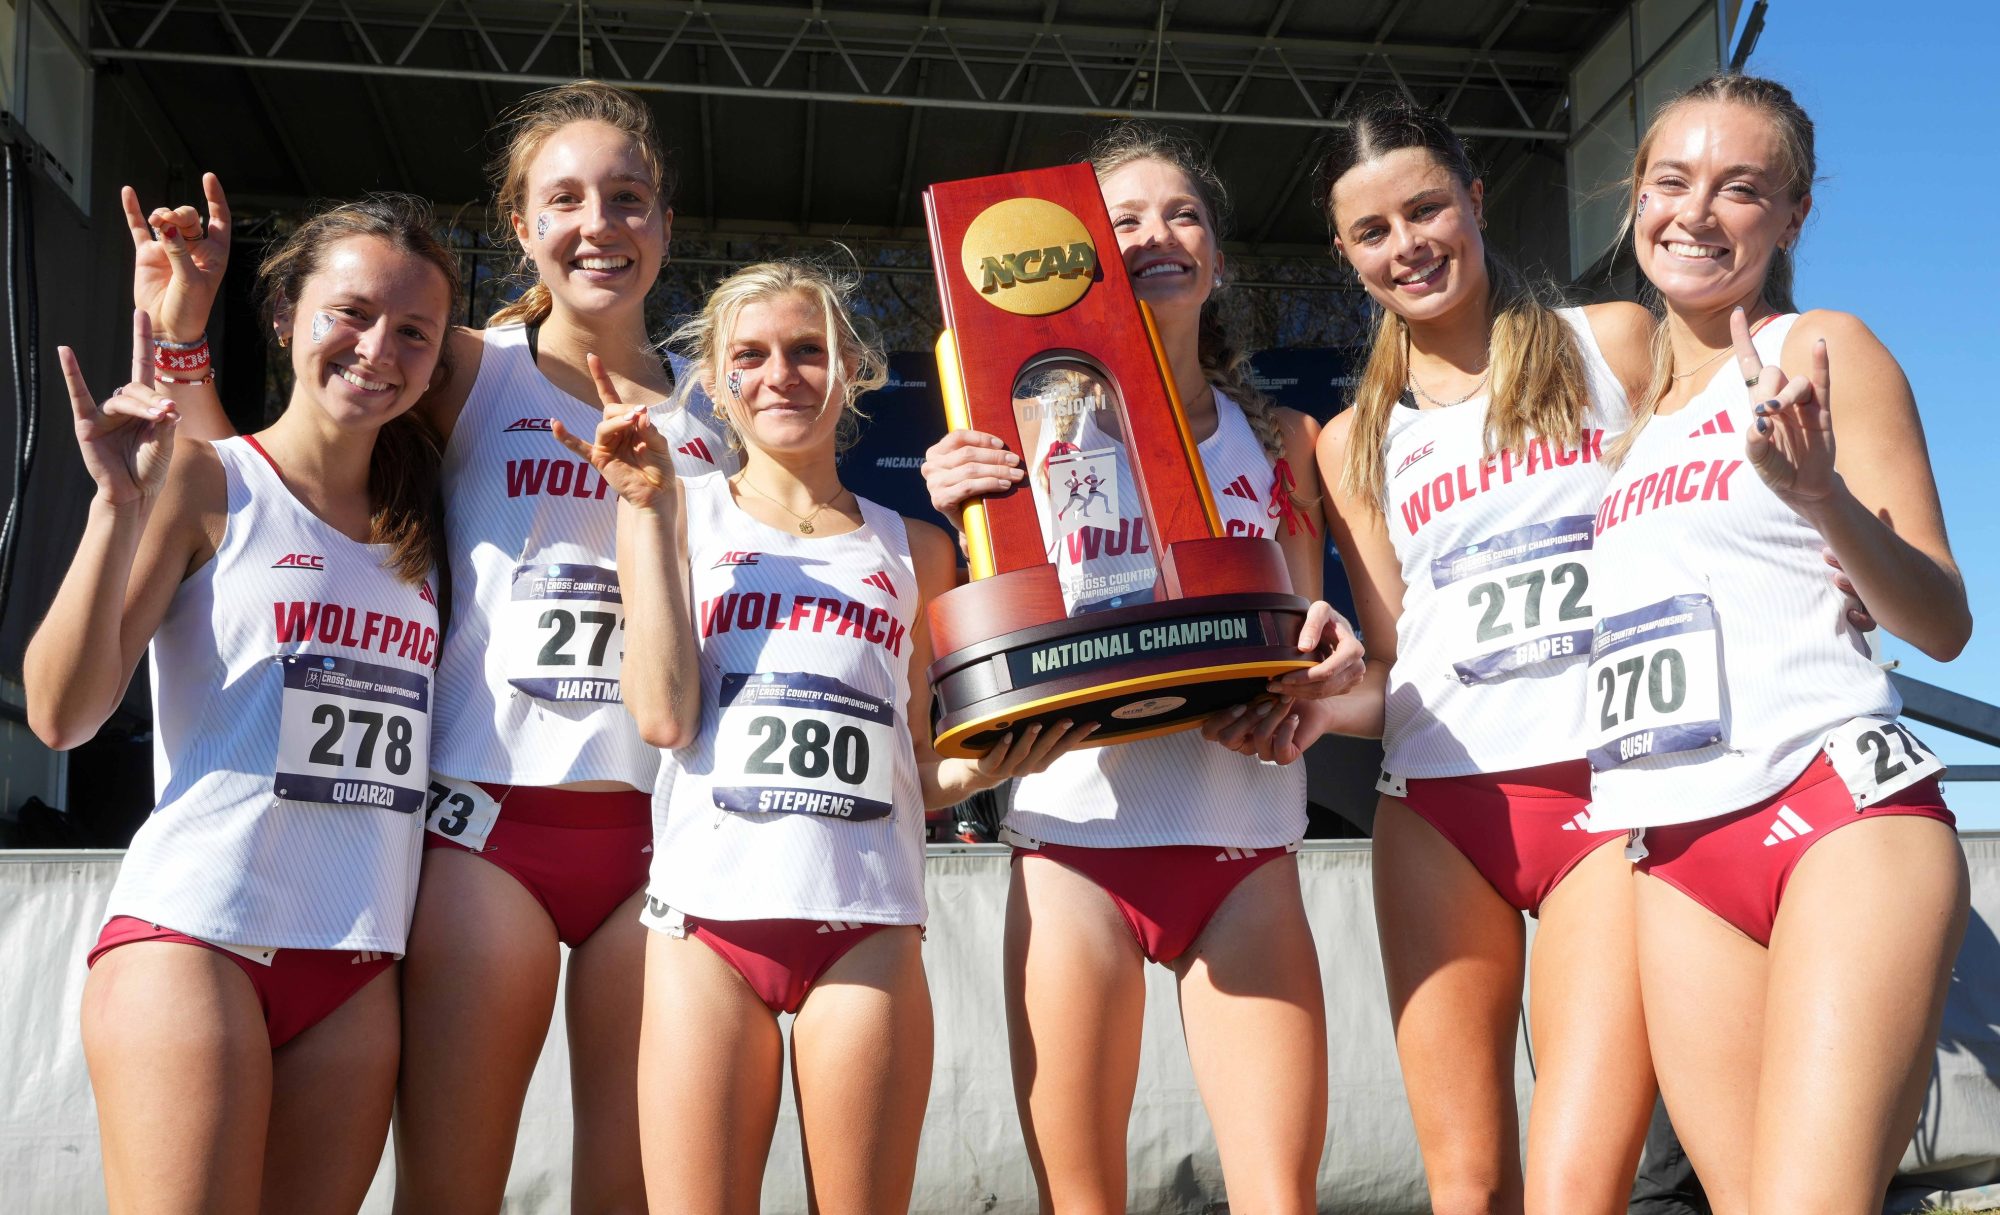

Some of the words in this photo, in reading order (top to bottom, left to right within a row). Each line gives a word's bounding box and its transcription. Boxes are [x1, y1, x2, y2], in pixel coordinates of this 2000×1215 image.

[981, 241, 1097, 294] NCAA
[509, 418, 552, 429] ACC
[1396, 440, 1435, 473] ACC
[1528, 532, 1589, 551] CHAMPIONSHIPS
[276, 553, 324, 567] ACC
[715, 551, 763, 566] ACC
[547, 581, 571, 590] CROSS
[573, 582, 606, 592] COUNTRY
[1072, 576, 1107, 592] CROSS
[1109, 567, 1159, 586] COUNTRY
[1467, 562, 1593, 644] 272
[701, 591, 906, 658] WOLFPACK
[1637, 612, 1694, 634] CHAMPIONSHIPS
[1032, 632, 1134, 674] NATIONAL
[1139, 617, 1248, 651] CHAMPION
[321, 674, 344, 685] CROSS
[345, 678, 374, 691] COUNTRY
[374, 683, 420, 700] CHAMPIONSHIPS
[758, 687, 785, 697] CROSS
[786, 689, 822, 700] COUNTRY
[823, 692, 879, 713] CHAMPIONSHIPS
[1597, 648, 1687, 732] 270
[308, 703, 413, 776] 278
[743, 715, 870, 785] 280
[1620, 731, 1654, 761] BUSH
[332, 782, 395, 807] QUARZO
[758, 790, 856, 817] STEPHENS
